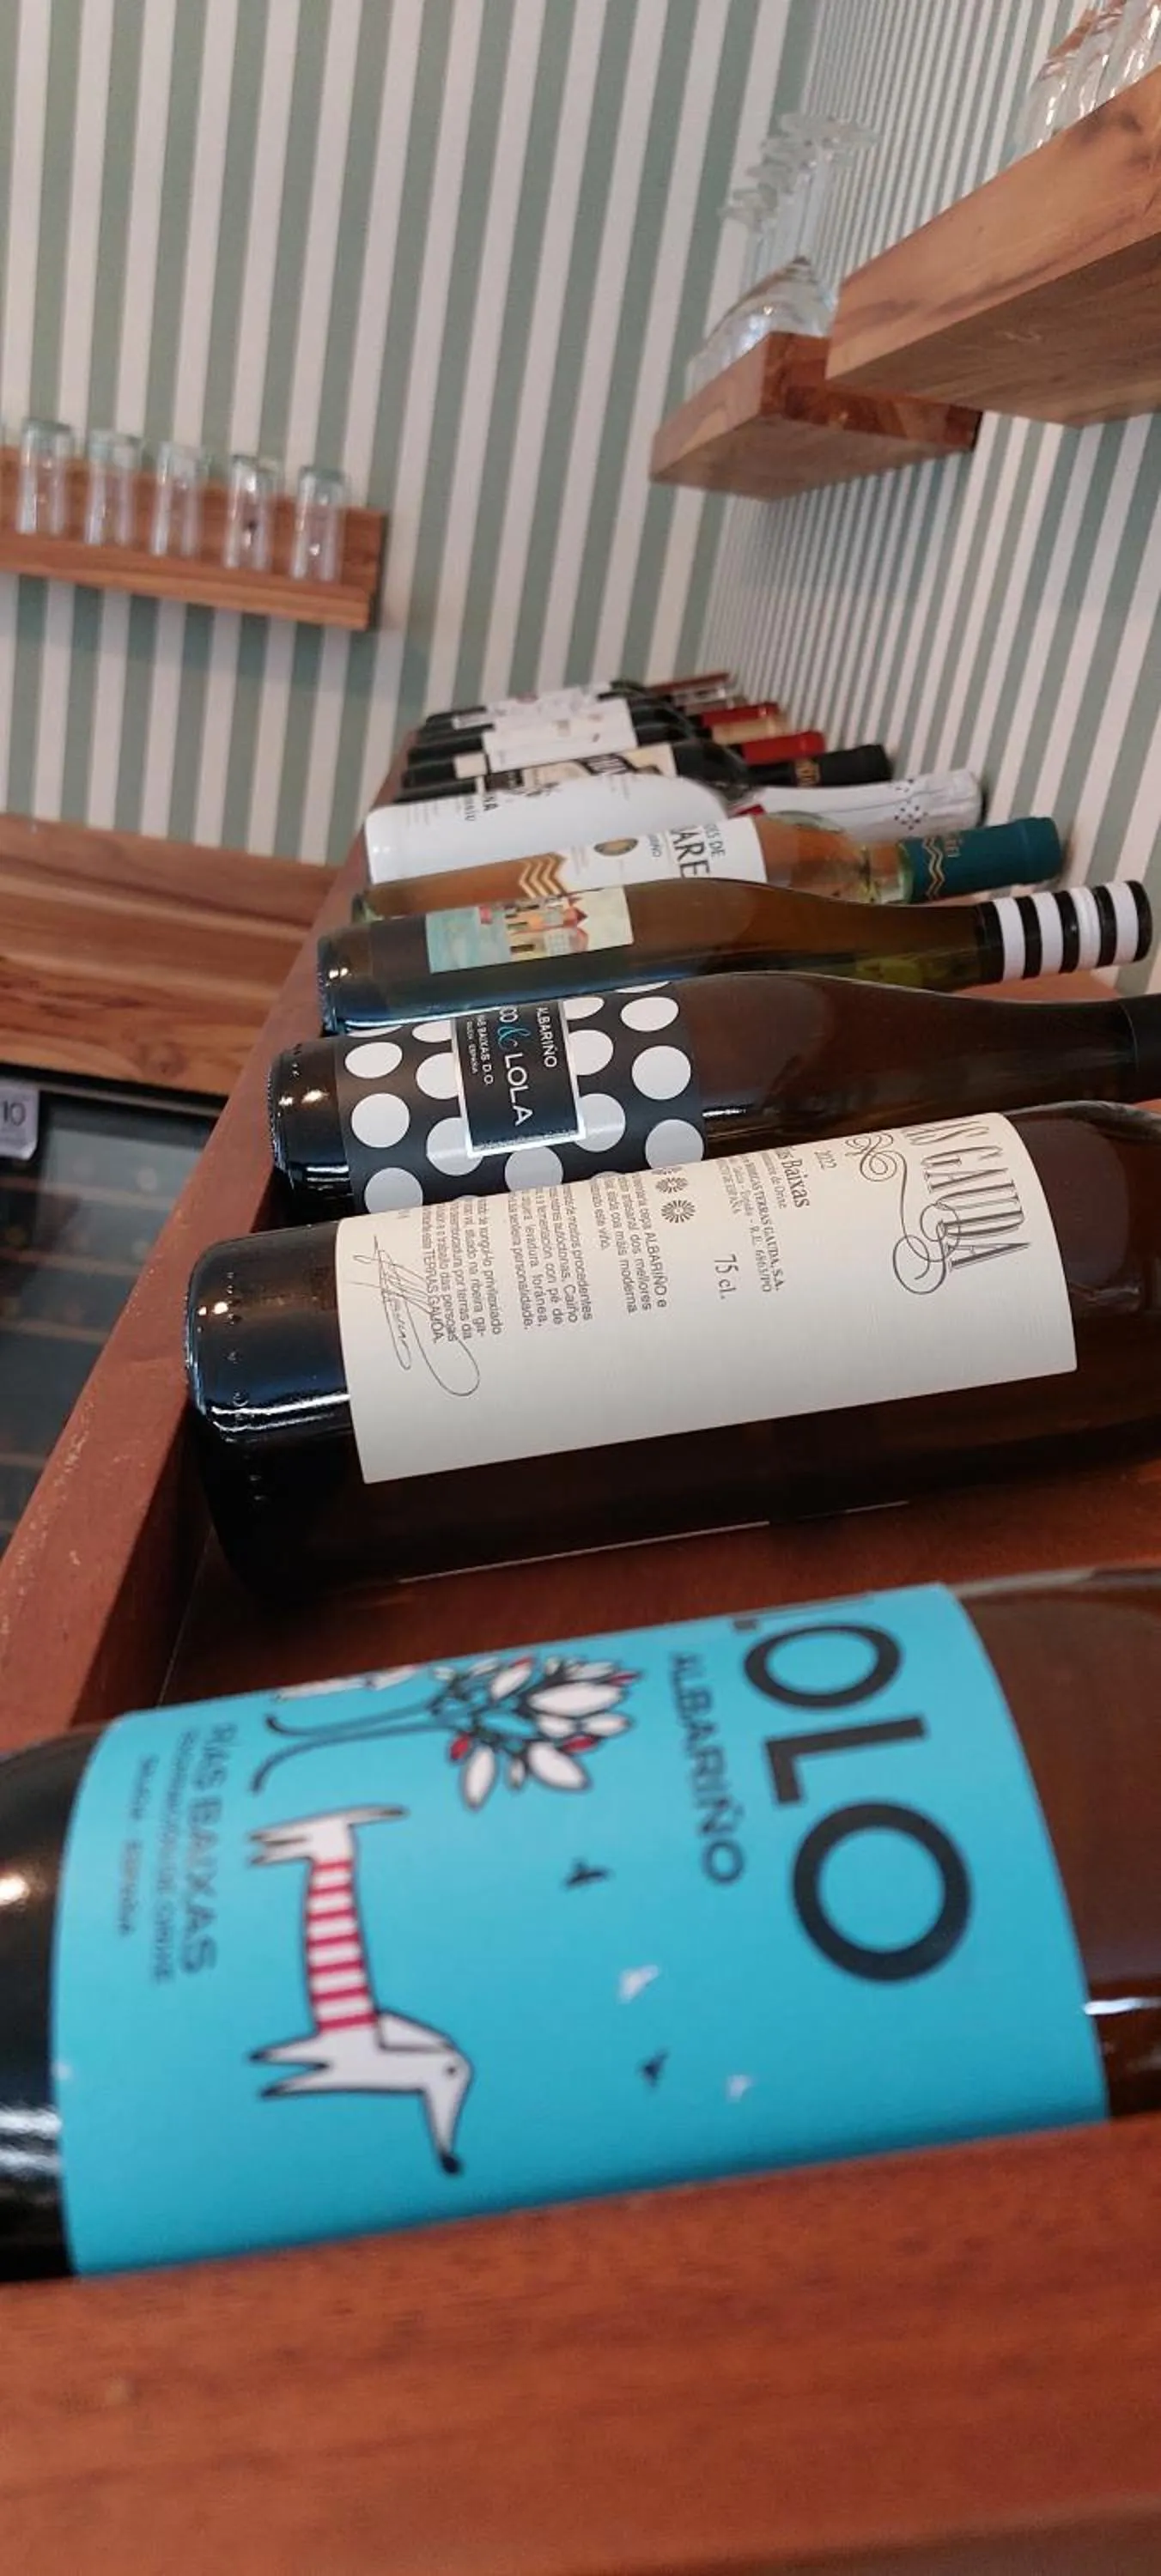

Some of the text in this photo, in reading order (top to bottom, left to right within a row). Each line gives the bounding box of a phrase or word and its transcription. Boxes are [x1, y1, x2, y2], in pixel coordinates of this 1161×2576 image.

[670, 825, 709, 877] ARE
[709, 841, 725, 859] DE
[536, 1007, 557, 1067] ALBARIÑO
[504, 1053, 532, 1126] LOLA
[781, 1159, 810, 1208] Baixas
[920, 1145, 1031, 1273] GAUDA
[629, 1234, 644, 1254] dos
[714, 1253, 739, 1273] 75
[752, 1191, 771, 1224] TERRAS
[772, 1267, 786, 1291] S.A.
[423, 1249, 438, 1294] TERRAS
[439, 1272, 453, 1291] das
[451, 1269, 465, 1286] por
[510, 1248, 533, 1330] personalidade.
[544, 1262, 556, 1284] con
[571, 1249, 593, 1321] procedentes
[618, 1259, 637, 1313] moderna
[635, 1258, 653, 1310] mellores
[645, 1231, 668, 1296] ALBARIÑO
[657, 1299, 666, 1308] e
[440, 1294, 458, 1341] persoas
[456, 1288, 471, 1321] terras
[469, 1278, 485, 1312] ribeira
[482, 1269, 503, 1334] privilexiado
[545, 1287, 560, 1303] pé
[551, 1307, 563, 1324] de
[461, 1323, 473, 1340] da
[672, 1654, 745, 1886] ALBARIÑO
[733, 1619, 976, 1984] OLO
[178, 1796, 223, 1975] BAIXAS
